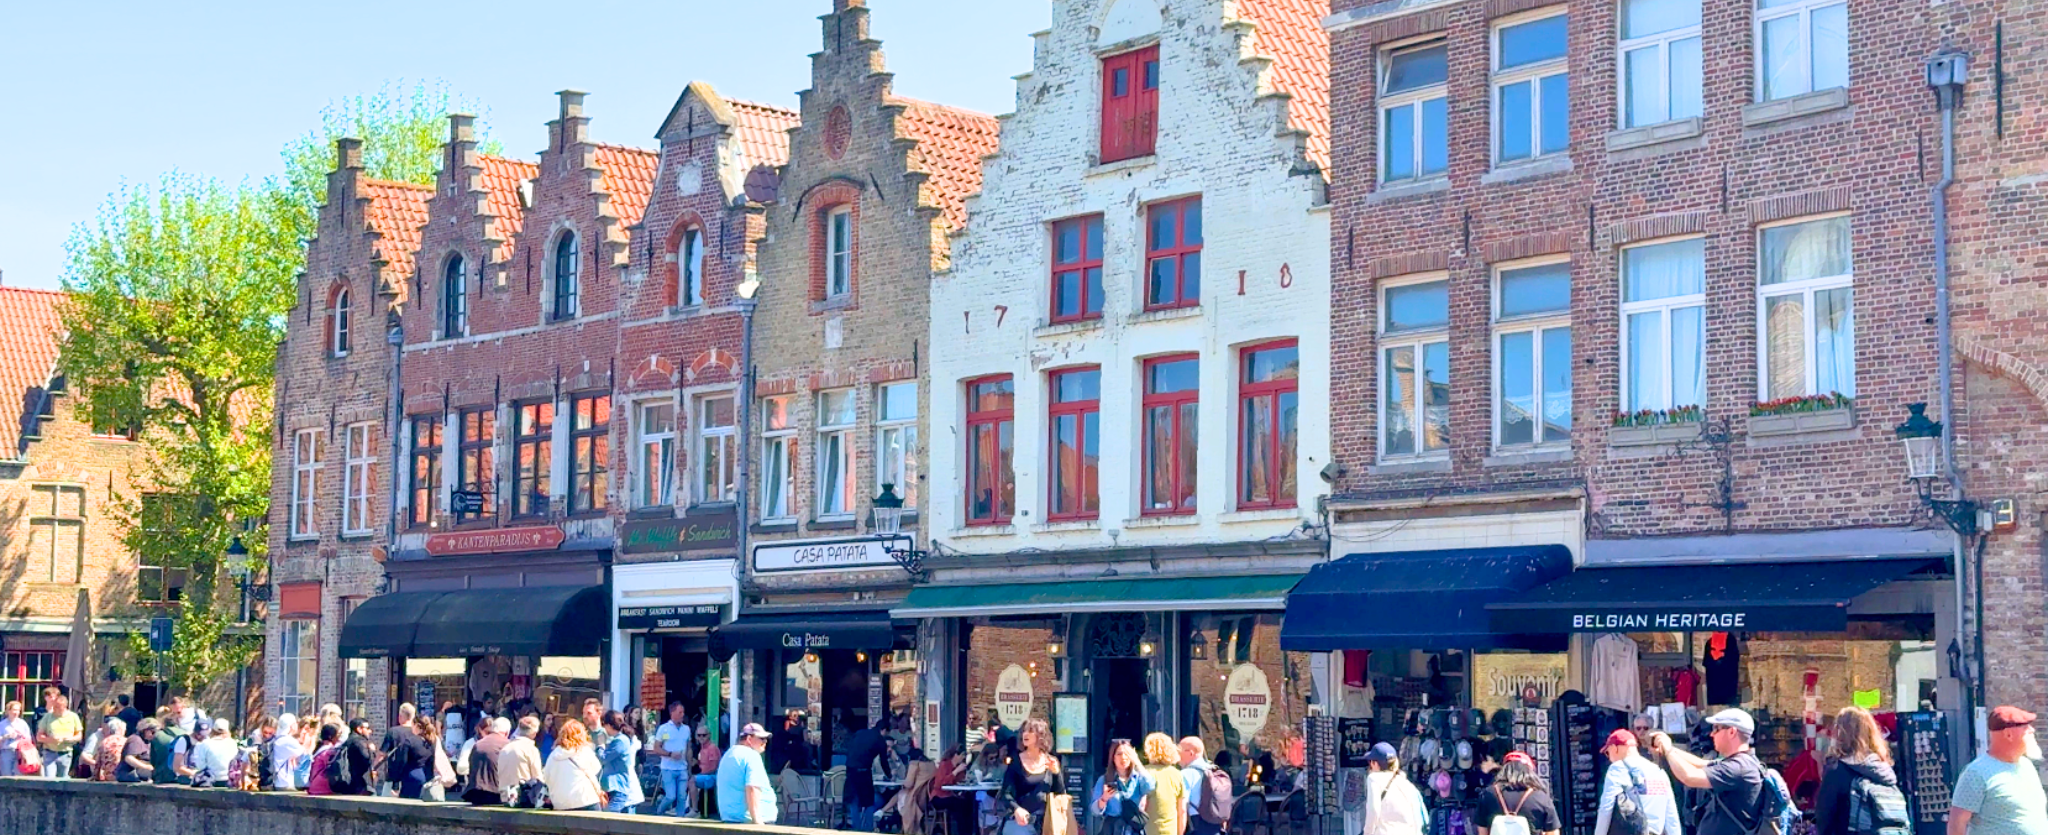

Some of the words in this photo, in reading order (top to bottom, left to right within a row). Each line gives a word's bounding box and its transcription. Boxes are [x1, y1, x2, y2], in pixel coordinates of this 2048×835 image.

[687, 521, 732, 541] Sandwich
[457, 533, 531, 549] KANTENPARADIJS
[793, 547, 824, 564] CASA
[827, 545, 868, 562] PATATA
[649, 607, 675, 616] SANDWICH
[1573, 614, 1648, 628] BELGIAN
[1655, 613, 1746, 628] HERITAGE
[782, 632, 802, 647] Casa
[804, 632, 830, 647] Patata
[1006, 704, 1023, 714] 1718
[1238, 707, 1259, 719] 1718
